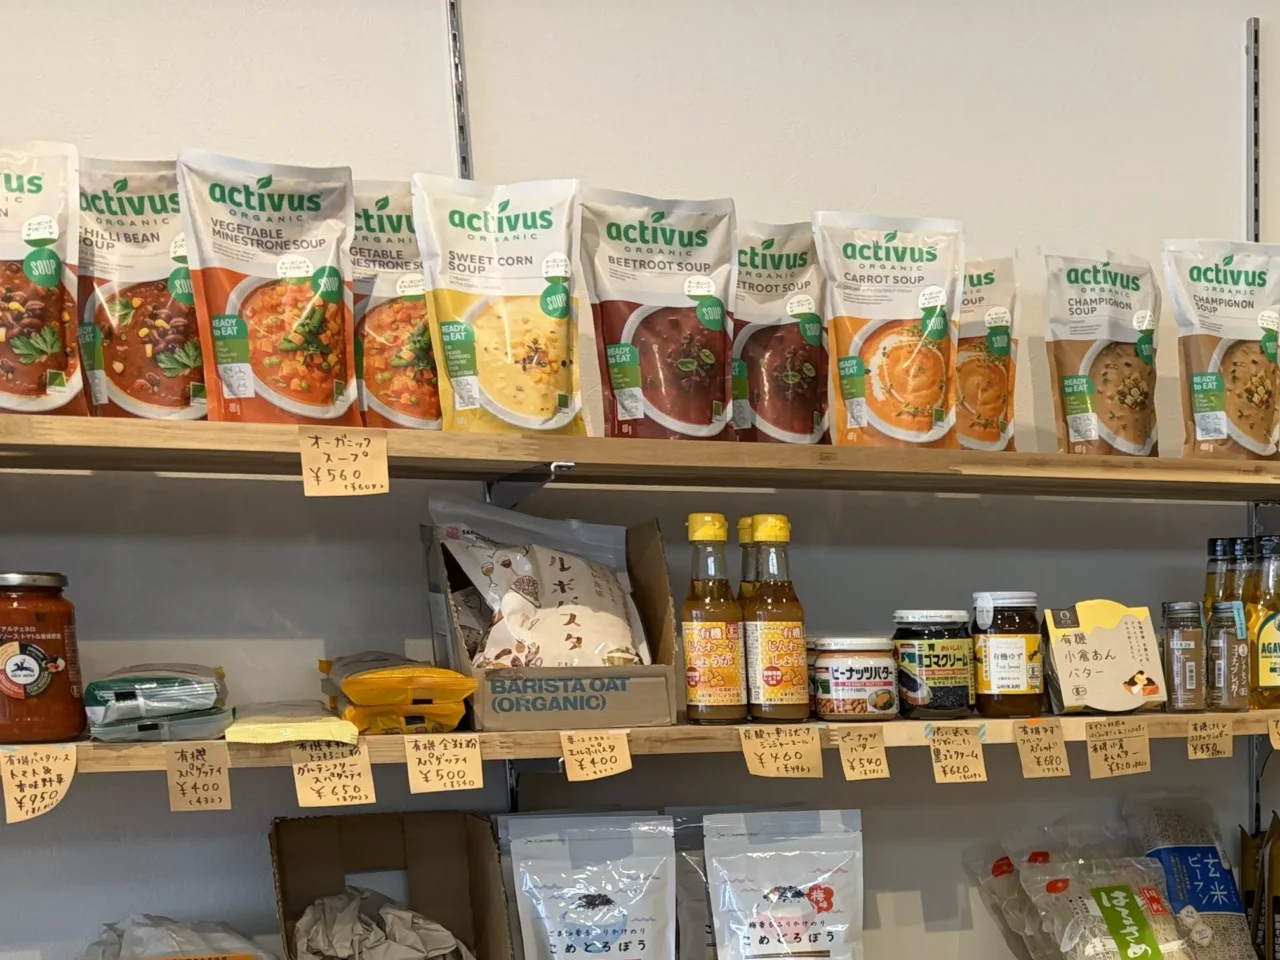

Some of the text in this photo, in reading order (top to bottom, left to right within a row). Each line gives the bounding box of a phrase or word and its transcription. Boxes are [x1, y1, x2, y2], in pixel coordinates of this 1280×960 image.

[209, 183, 322, 213] activus
[96, 217, 171, 227] ORGANIC
[229, 209, 304, 222] ORGANIC
[449, 209, 554, 234] activus
[210, 217, 284, 239] VEGETABLE
[606, 221, 709, 248] activus
[123, 232, 161, 244] BEAN
[212, 229, 327, 251] MINESTRONE SOUP
[624, 246, 693, 257] ORGANIC
[843, 242, 938, 263] activus
[449, 251, 533, 267] SWEET CORN
[608, 256, 712, 273] BEETROOT SOUP
[30, 258, 57, 277] SOUP
[449, 262, 487, 275] SOUP
[844, 272, 925, 285] CARROT SOUP
[1067, 267, 1141, 292] activus
[1189, 264, 1268, 288] activus
[317, 275, 339, 296] SOUP
[782, 281, 811, 293] SOUP
[1080, 287, 1131, 298] ORGANIC
[1204, 286, 1255, 296] ORGANIC
[547, 293, 567, 310] SOUP
[1068, 298, 1132, 311] CHAMPIGNON
[1193, 294, 1255, 310] CHAMPIGNON
[1195, 302, 1219, 314] SOUP
[702, 307, 722, 321] SOUP
[1068, 306, 1097, 316] SOUP
[450, 333, 467, 341] EAT
[1074, 384, 1088, 392] EAT
[1203, 381, 1217, 390] EAT
[308, 434, 372, 447] オーガニック
[324, 452, 369, 463] スープ
[309, 467, 361, 485] ¥560
[700, 627, 722, 640] 有機
[1060, 632, 1087, 646] 有機
[690, 654, 733, 667] しょうが
[993, 652, 1023, 661] 有機ゆず
[1064, 649, 1116, 663] 小倉あん
[831, 666, 893, 681] ピーナッツバター
[1068, 667, 1104, 679] バター
[490, 677, 631, 694] BARISTA OAT
[491, 694, 607, 714] (ORGANIC)
[406, 739, 437, 750] 有機
[1191, 743, 1217, 755] ¥550
[174, 748, 207, 762] 有機
[416, 752, 468, 766] スパゲッティ
[753, 750, 803, 767] ¥460
[1034, 755, 1062, 767] ¥680
[177, 762, 223, 778] スパゲッティ
[574, 756, 618, 771] ¥400
[846, 757, 882, 772] ¥540
[940, 764, 969, 776] ¥620
[1107, 761, 1132, 772] ¥520
[419, 769, 466, 782] ¥500
[176, 781, 219, 797] ¥400
[310, 785, 361, 800] ¥650
[14, 790, 59, 811] ¥950
[1203, 856, 1230, 905] 玄米
[1100, 889, 1152, 960] はるさめ
